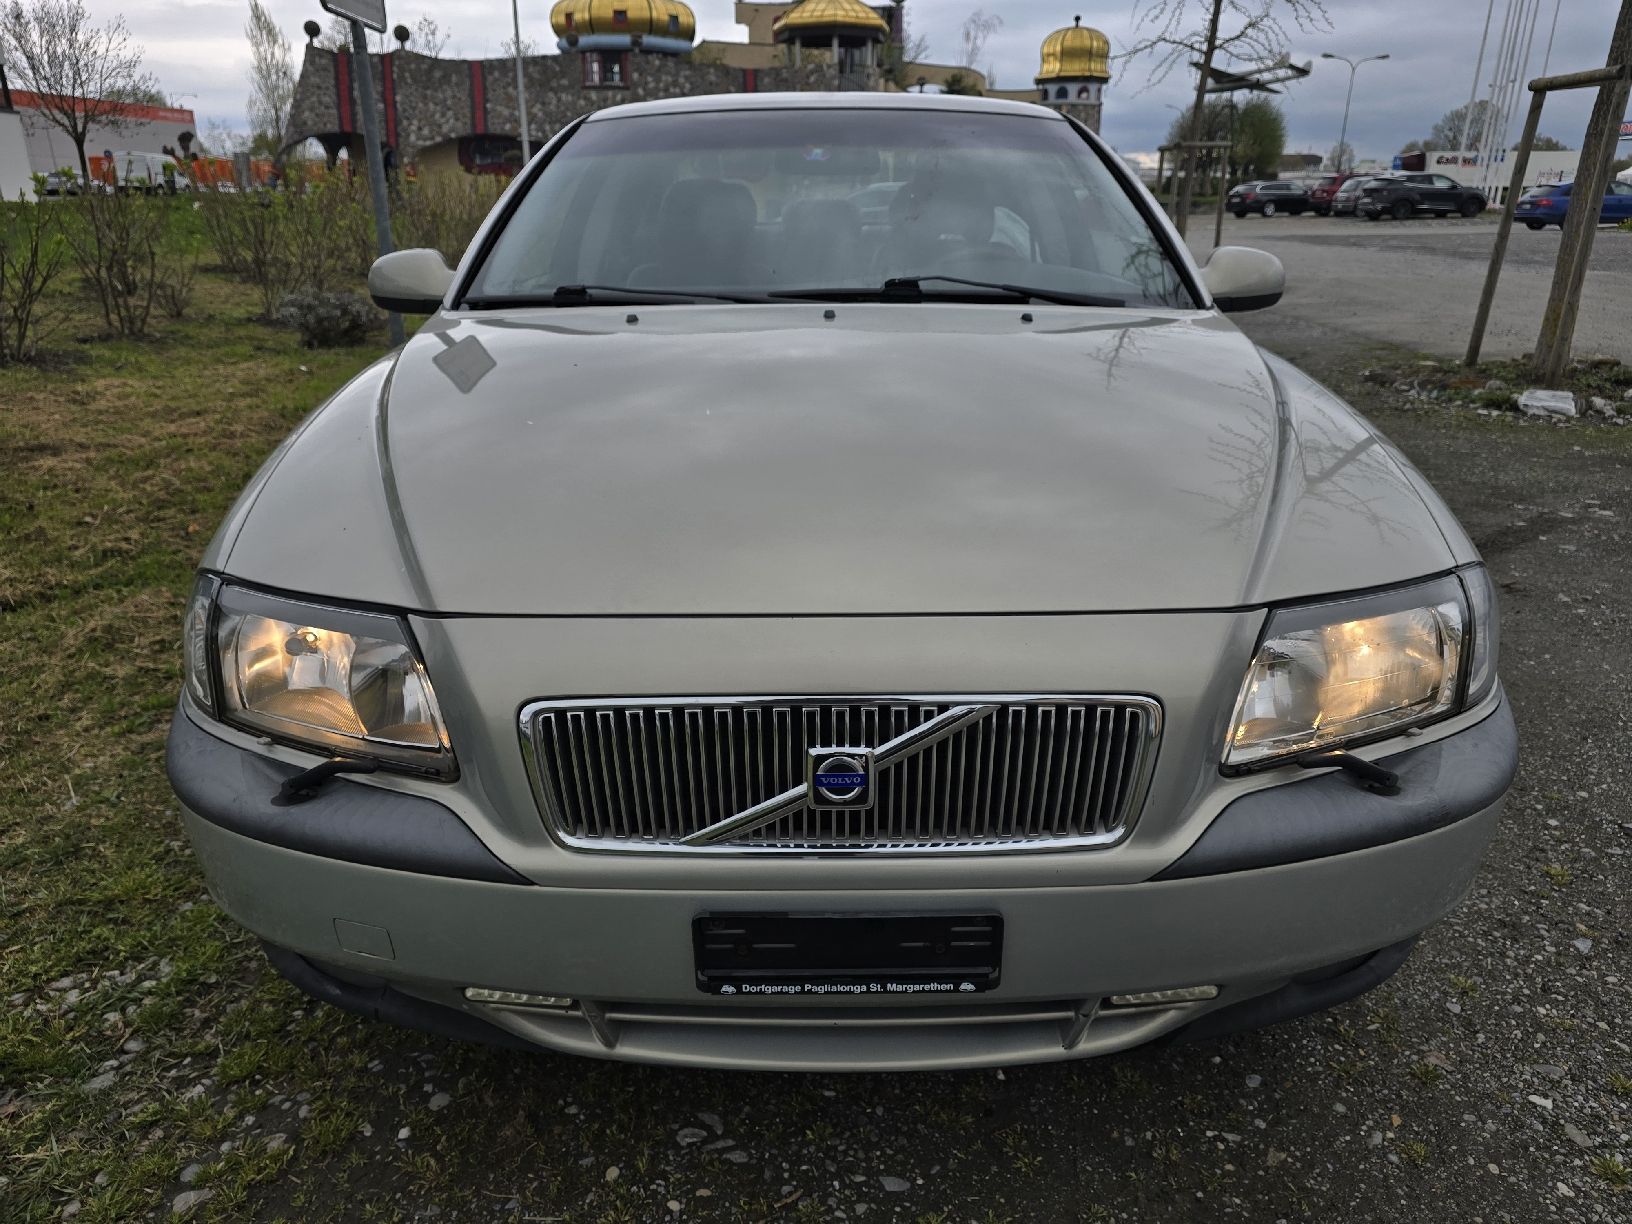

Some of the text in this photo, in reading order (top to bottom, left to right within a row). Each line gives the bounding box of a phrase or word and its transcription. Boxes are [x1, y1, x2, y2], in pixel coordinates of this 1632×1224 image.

[742, 982, 954, 994] Dorfgarage Paglialonga St. Margarethen
